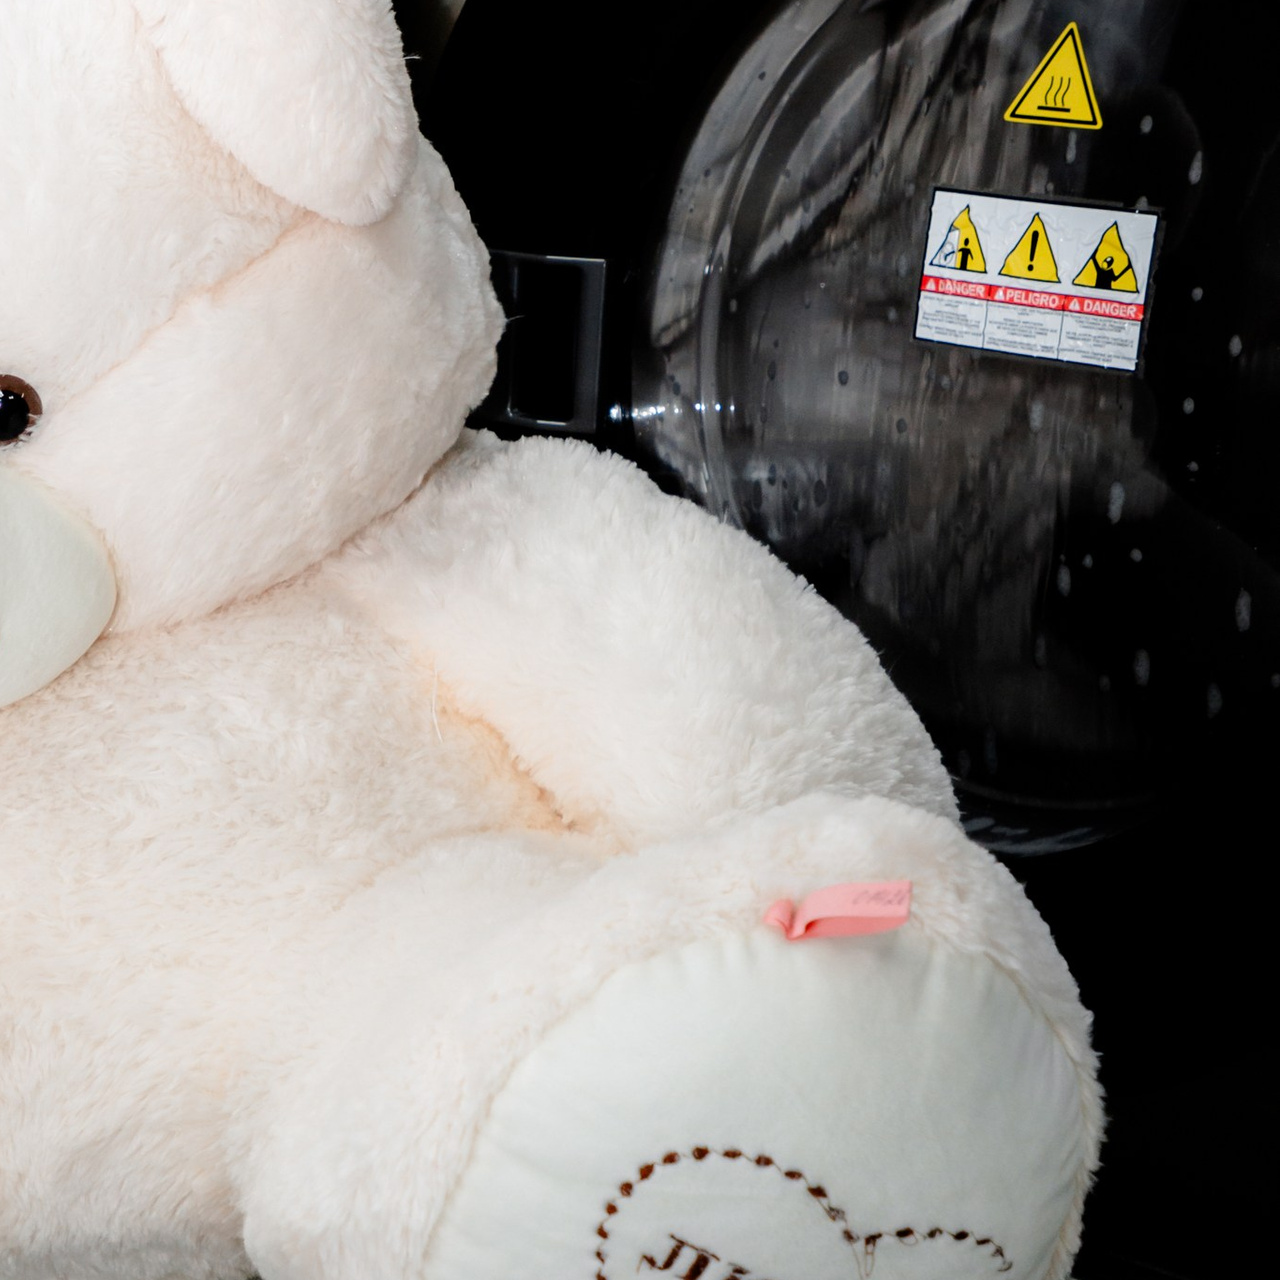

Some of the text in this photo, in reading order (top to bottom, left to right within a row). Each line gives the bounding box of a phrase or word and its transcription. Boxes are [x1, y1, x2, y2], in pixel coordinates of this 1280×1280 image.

[938, 280, 985, 296] DANGER
[1006, 290, 1059, 308] PELIGRO
[1083, 298, 1137, 319] DANGER
